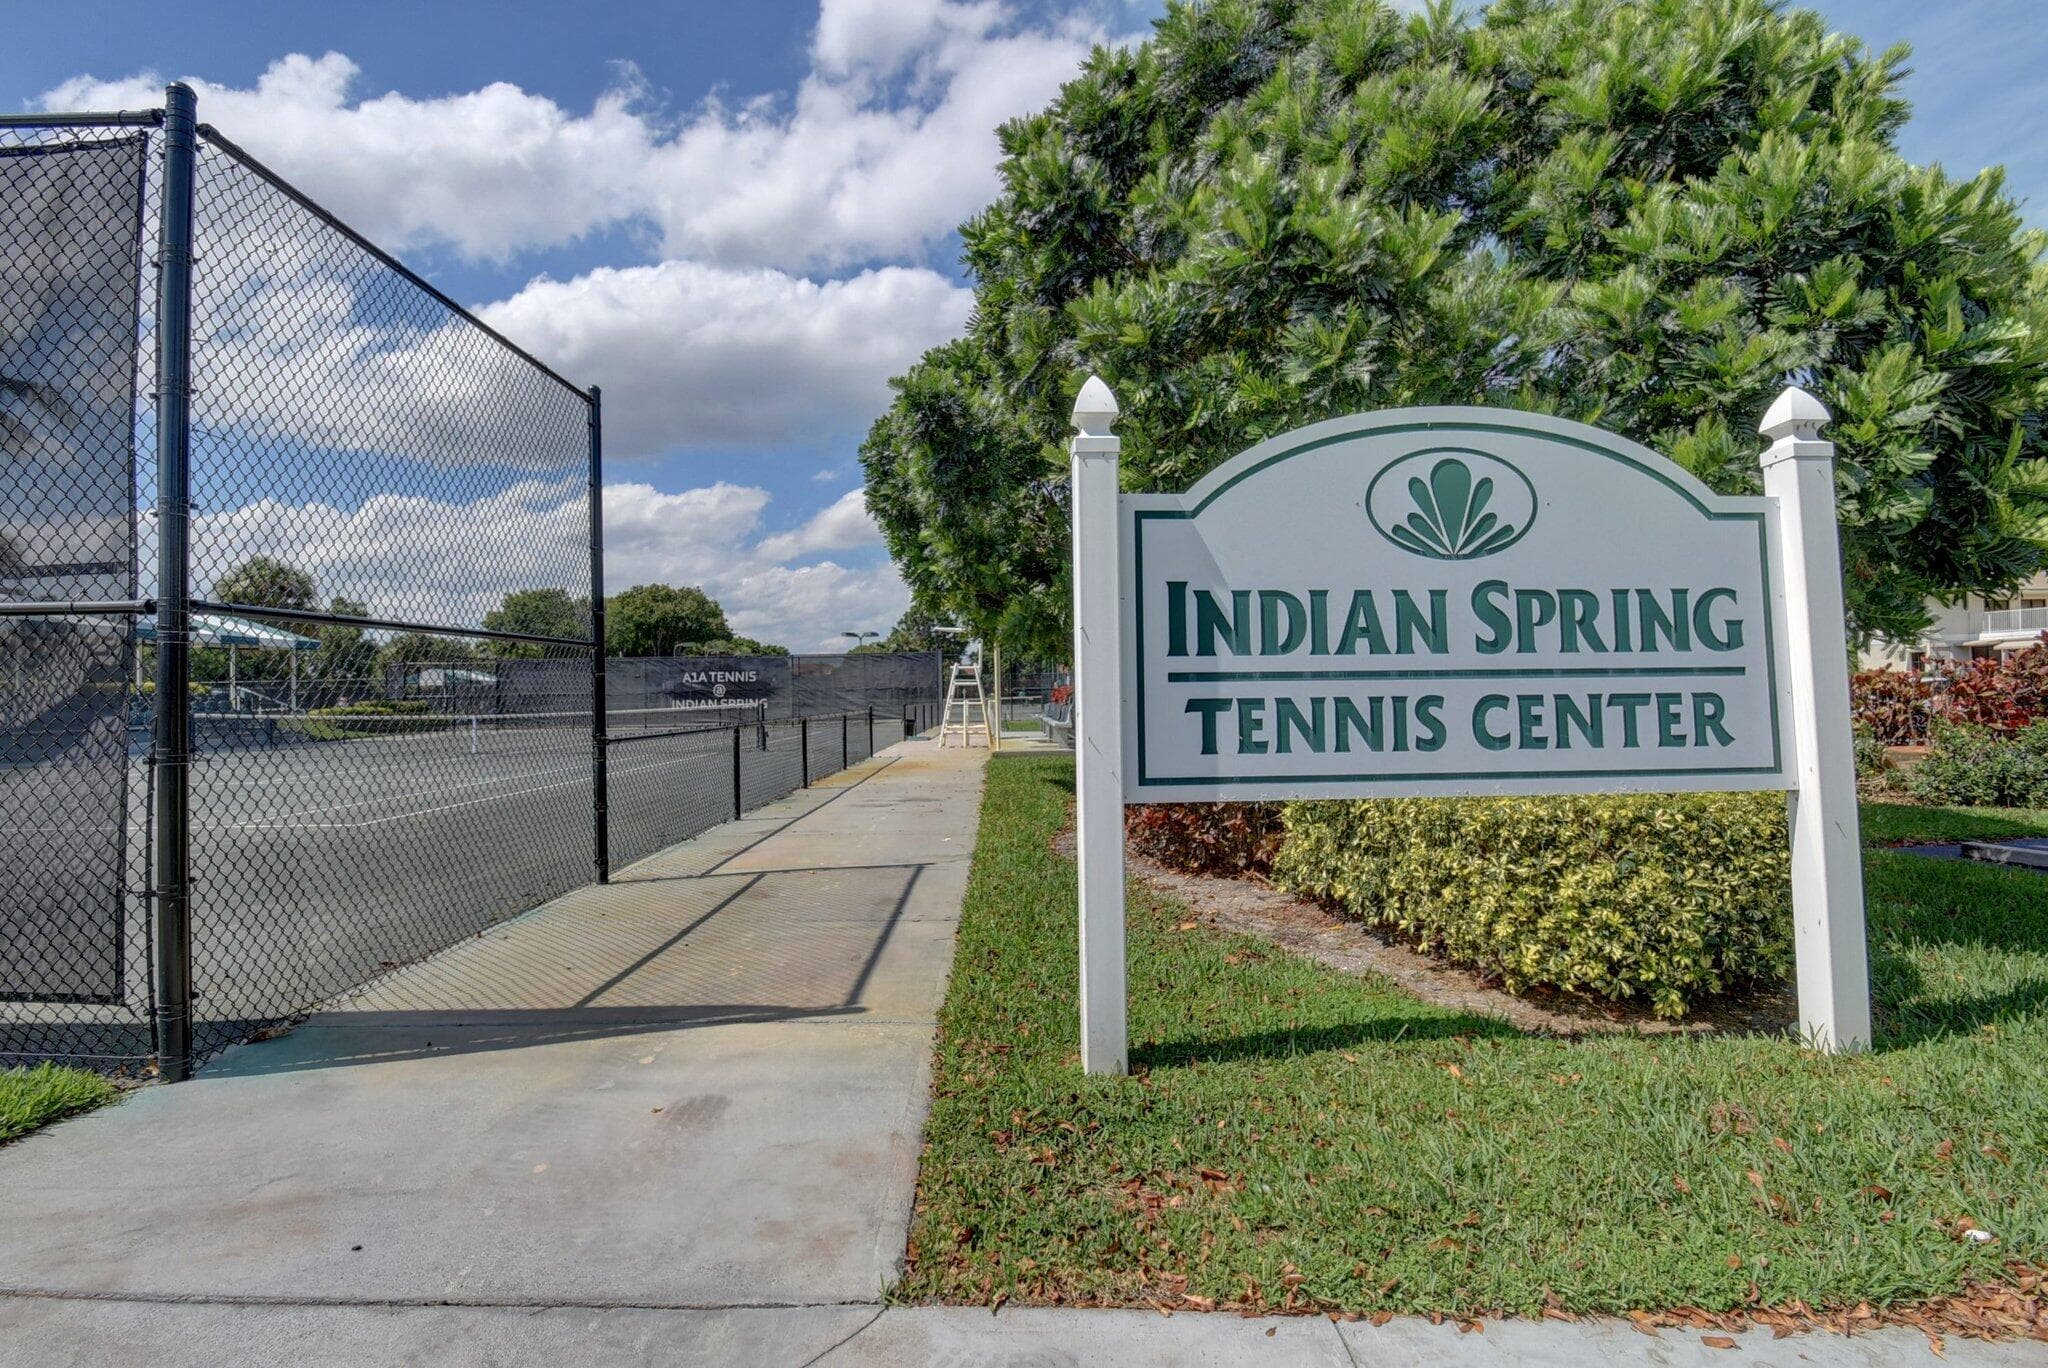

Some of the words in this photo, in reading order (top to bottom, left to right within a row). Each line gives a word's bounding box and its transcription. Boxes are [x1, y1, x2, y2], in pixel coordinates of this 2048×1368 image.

[1166, 581, 1450, 657] INDIAN
[1471, 579, 1744, 655] SPRING
[682, 671, 706, 682] A1A
[709, 671, 757, 682] TENNIS
[713, 684, 726, 697] @
[672, 699, 718, 709] INDIAN
[1184, 694, 1447, 755] TENNIS
[1472, 692, 1736, 751] CENTER
